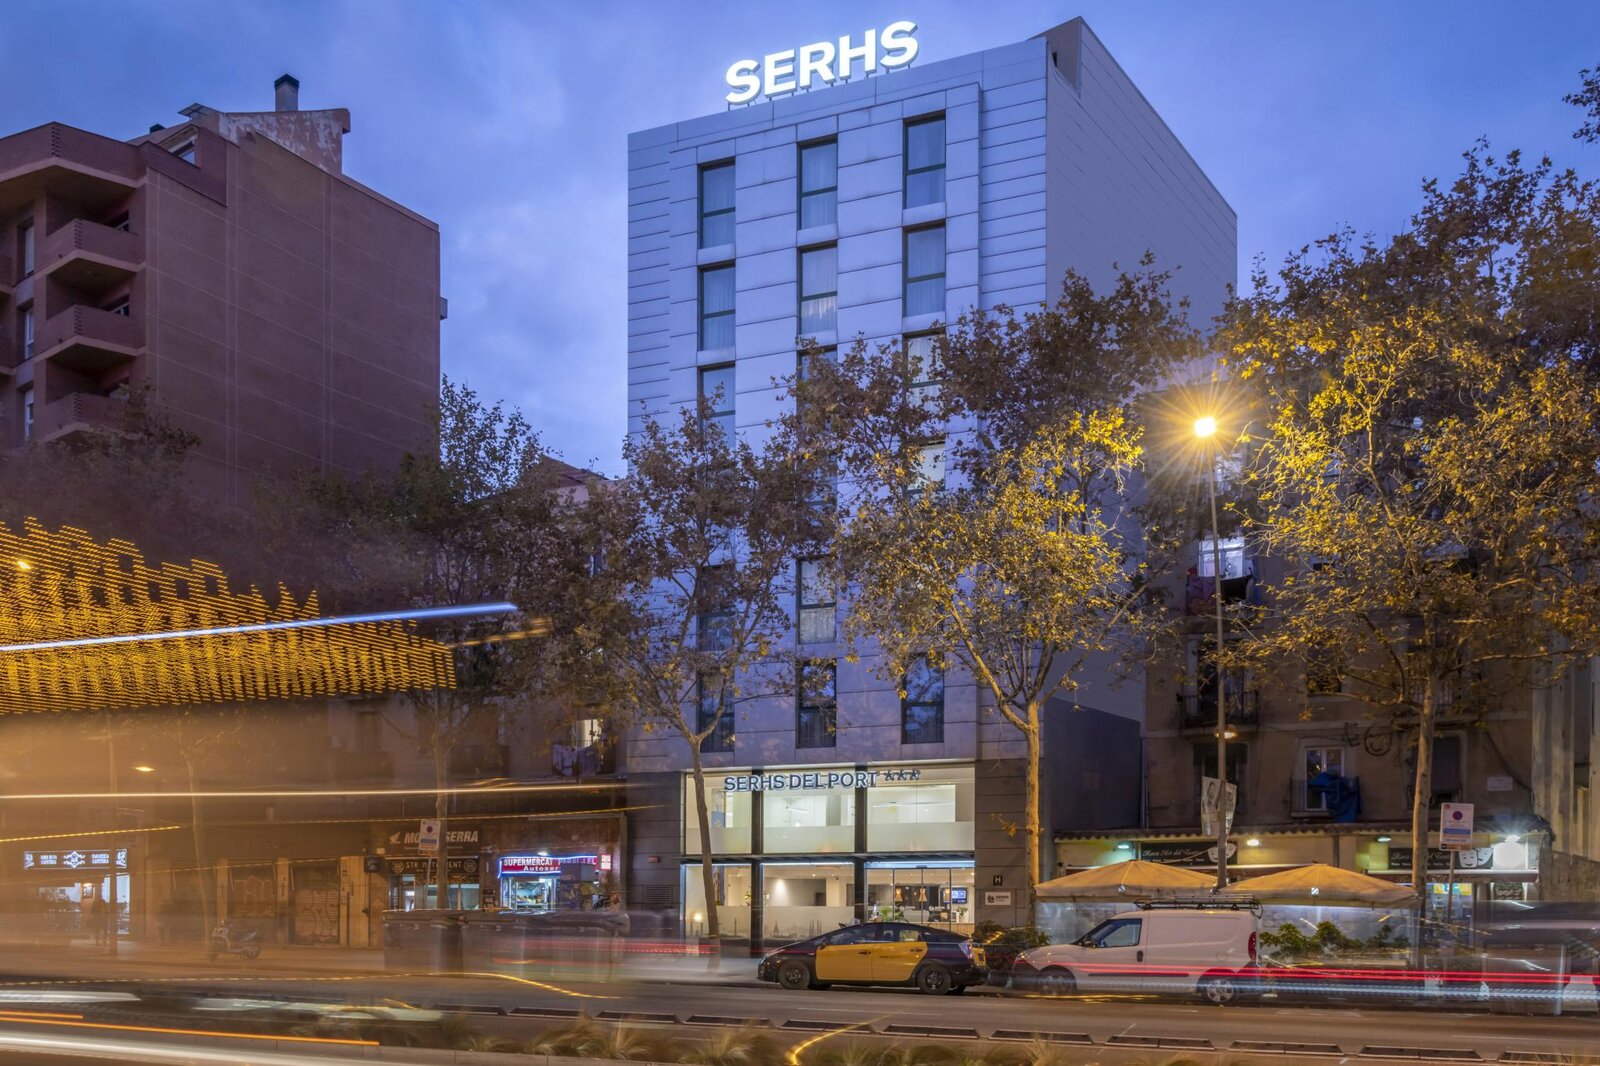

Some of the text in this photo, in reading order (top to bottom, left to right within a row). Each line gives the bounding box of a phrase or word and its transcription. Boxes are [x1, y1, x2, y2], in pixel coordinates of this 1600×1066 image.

[725, 20, 918, 106] SERHS
[724, 771, 878, 792] SERHS DEL PORT
